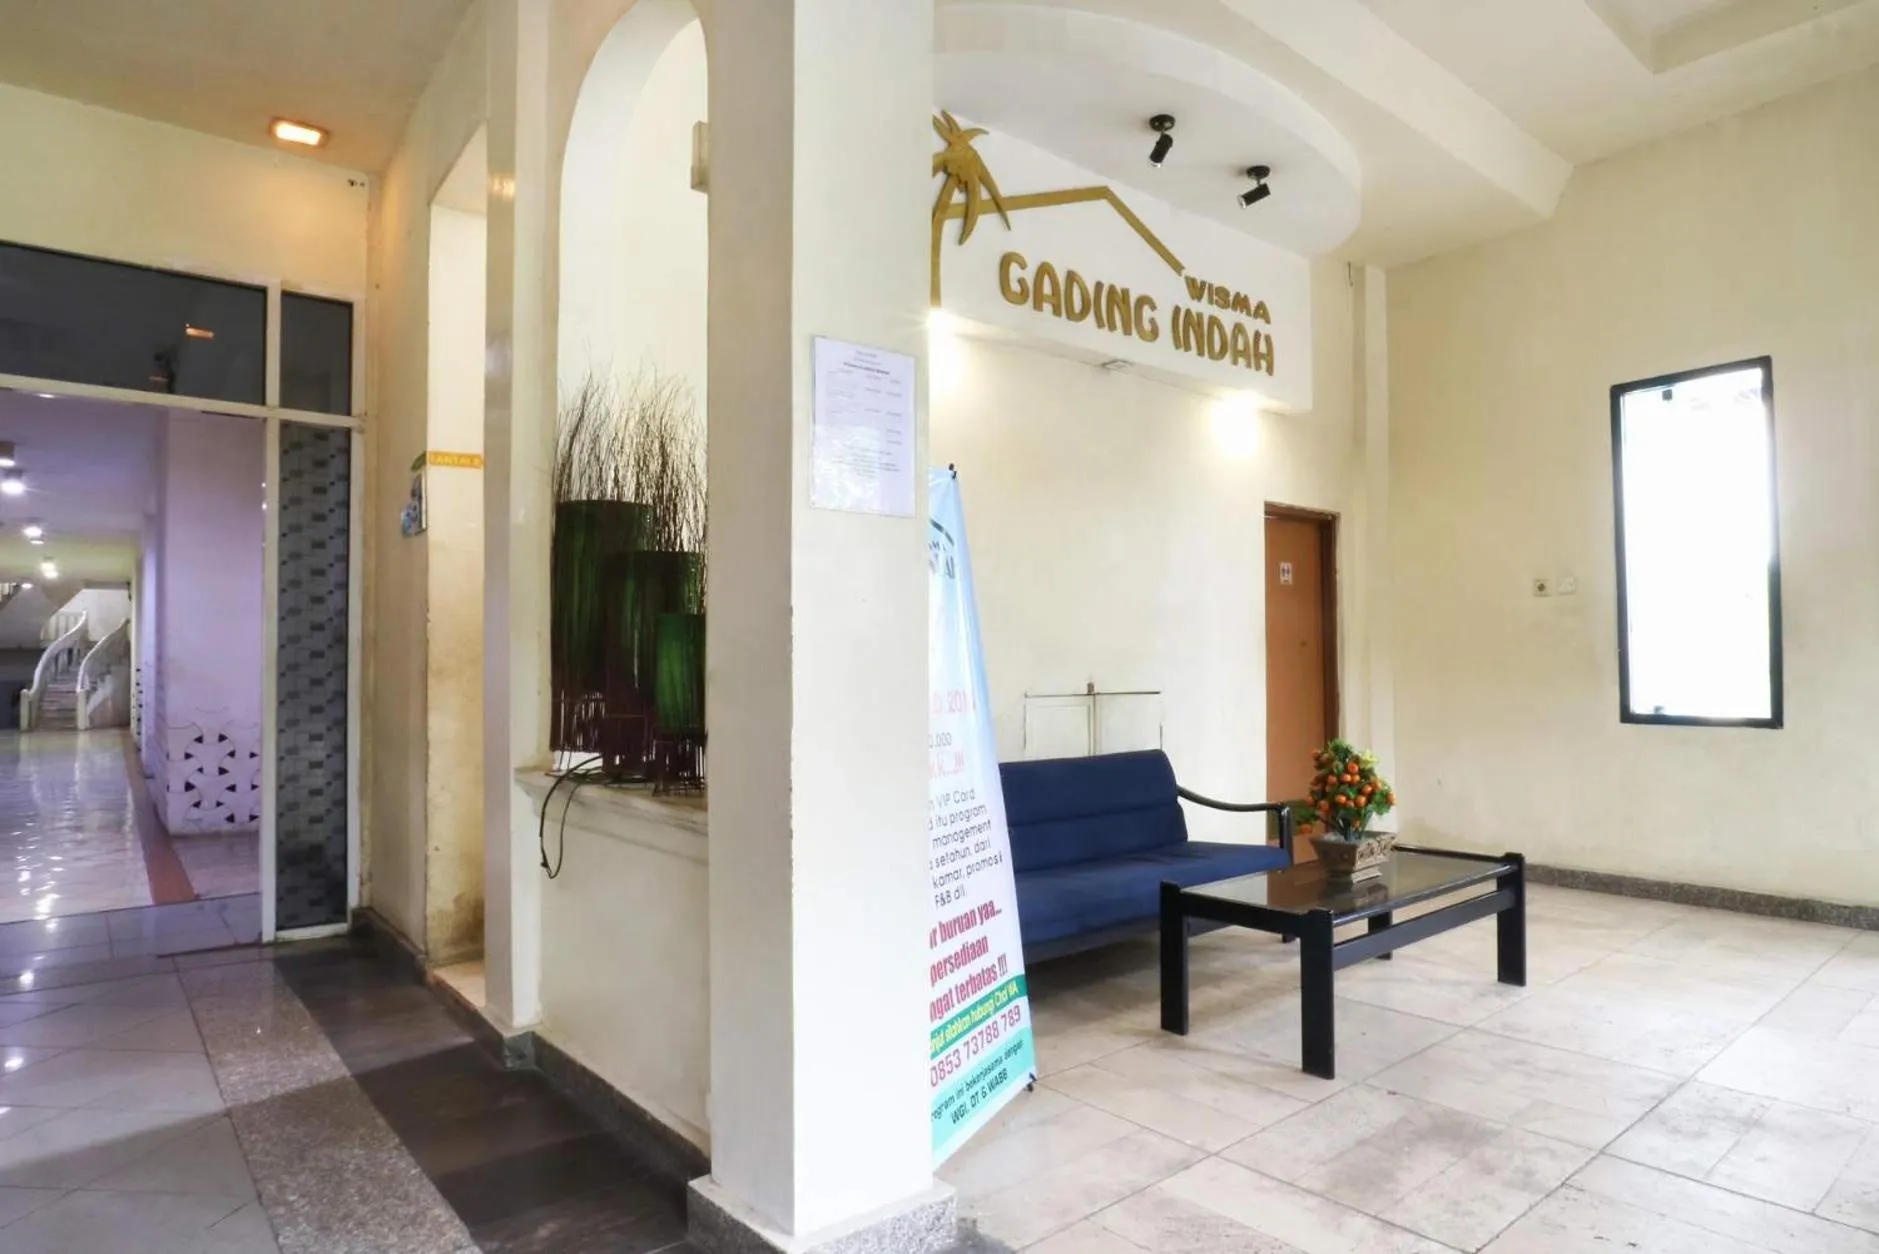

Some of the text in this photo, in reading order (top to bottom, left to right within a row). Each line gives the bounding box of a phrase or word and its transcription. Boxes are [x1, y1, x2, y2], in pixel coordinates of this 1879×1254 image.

[1000, 251, 1275, 376] GADING INDAH
[1184, 275, 1271, 325] WISMA
[935, 813, 948, 828] itu
[949, 804, 988, 826] program
[936, 793, 951, 808] VIP
[952, 788, 976, 804] Card
[932, 819, 992, 849] management
[965, 851, 1003, 876] promosi
[934, 889, 952, 908] F&B
[938, 908, 978, 944] buruan
[930, 934, 989, 988] persediaan
[955, 962, 998, 1005] terbatas
[930, 1005, 1021, 1087] 0853 73788 789
